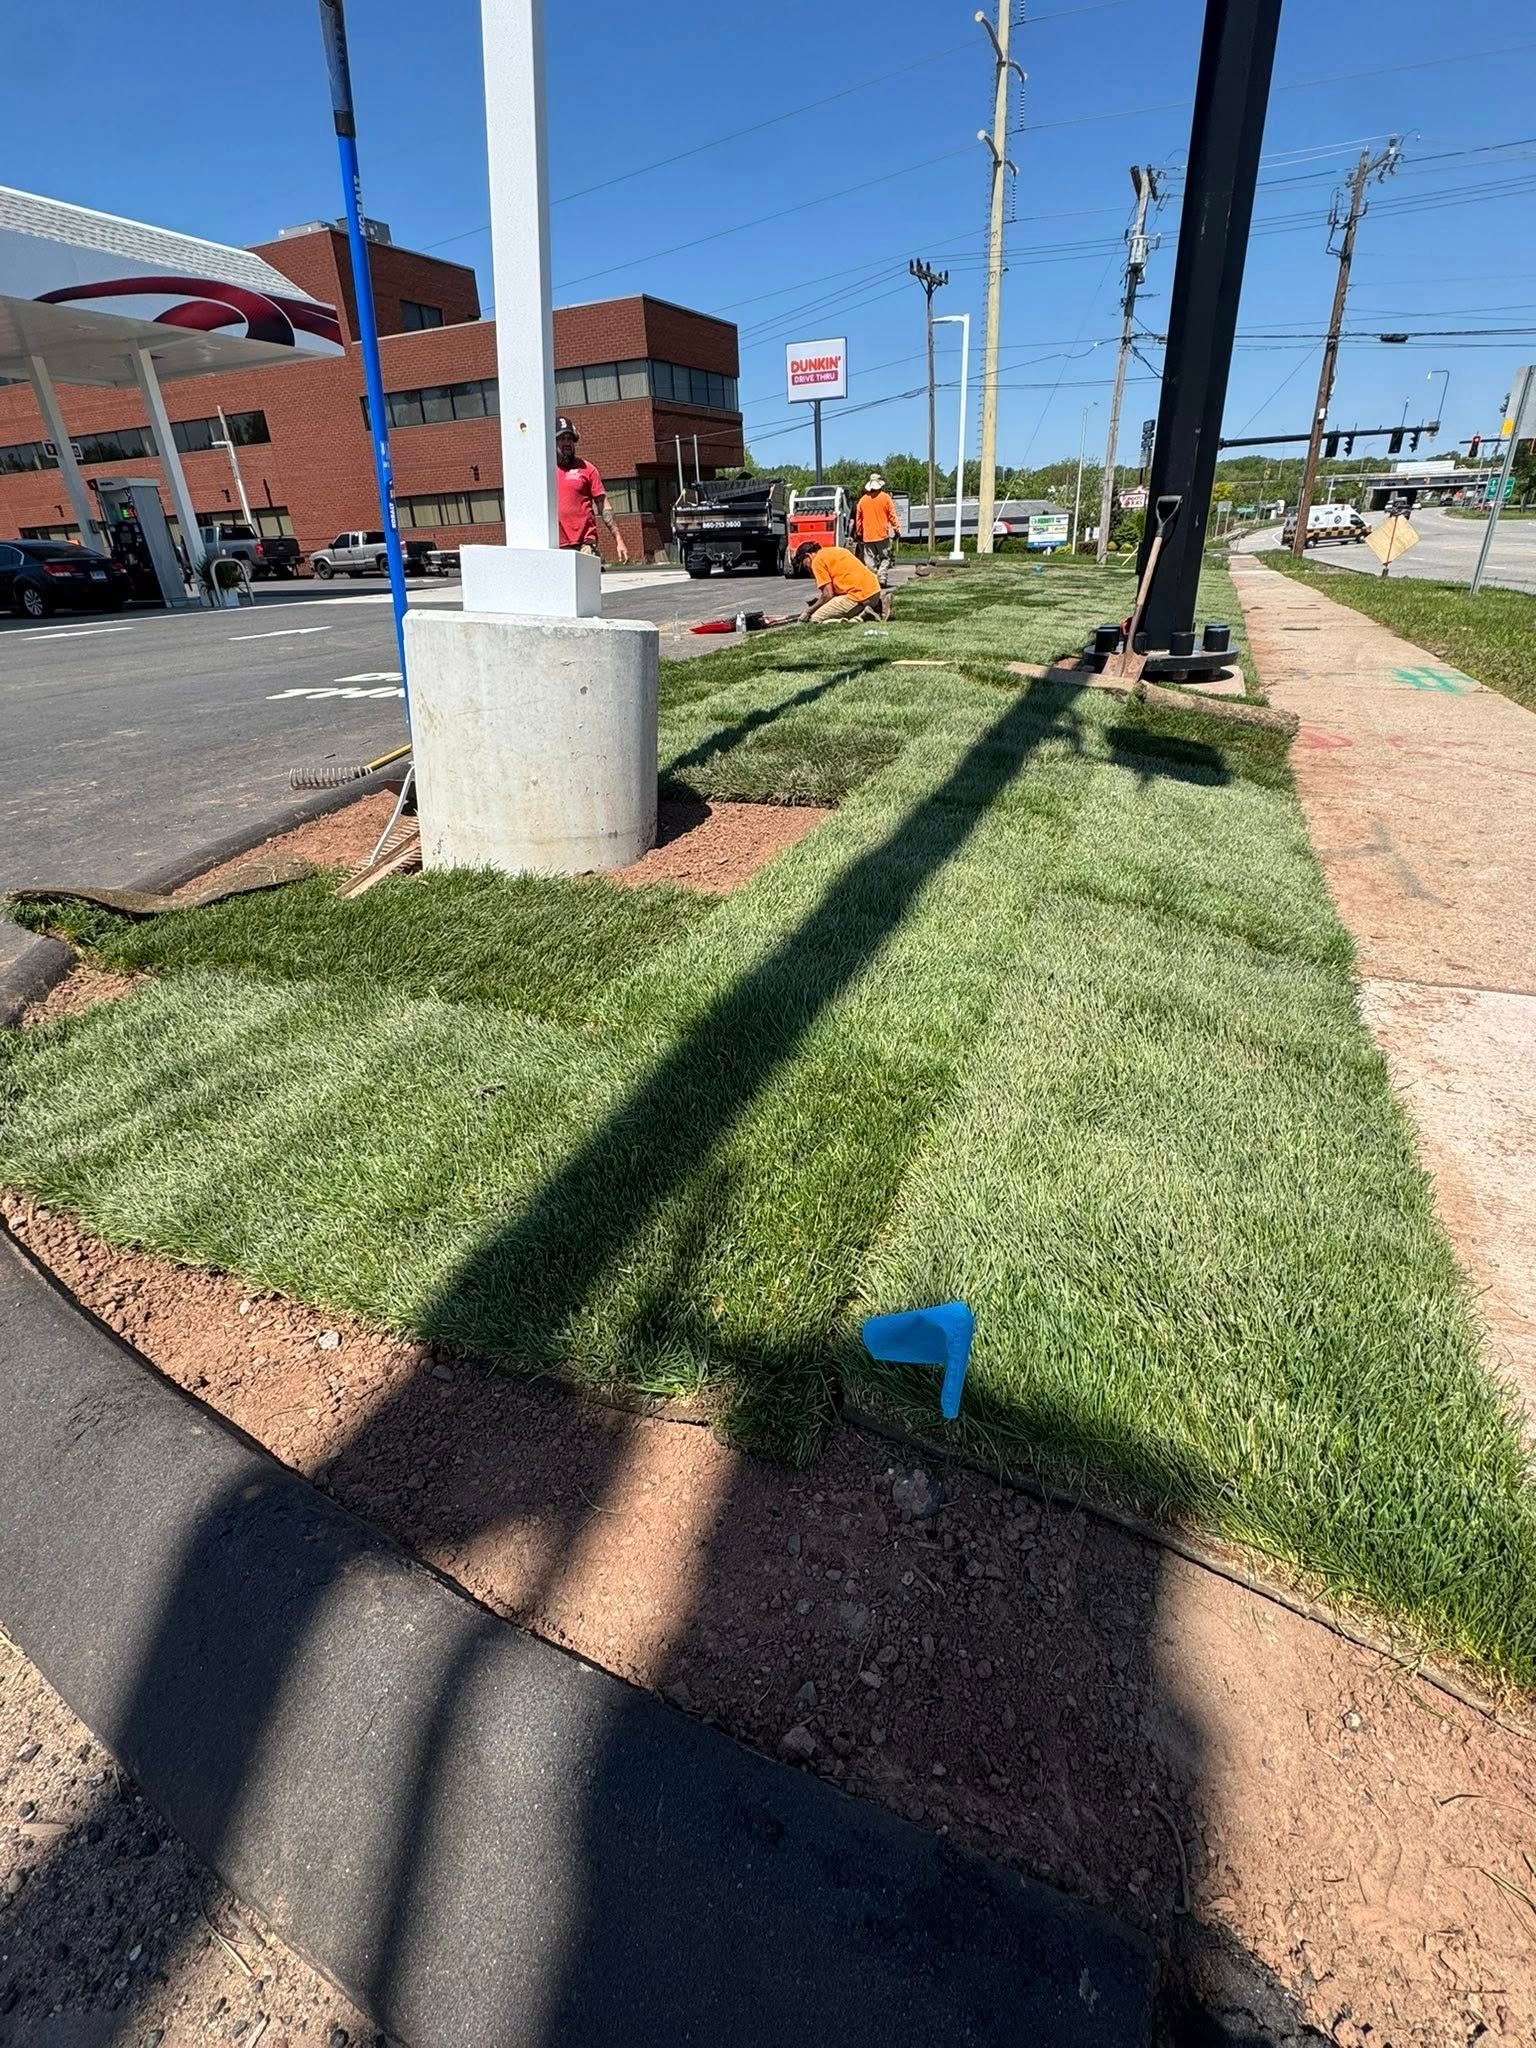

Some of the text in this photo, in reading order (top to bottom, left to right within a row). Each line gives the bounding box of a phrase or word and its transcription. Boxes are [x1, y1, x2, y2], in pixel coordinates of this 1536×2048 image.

[790, 356, 842, 373] DUNKIN'
[793, 372, 836, 384] DRIVE THRU
